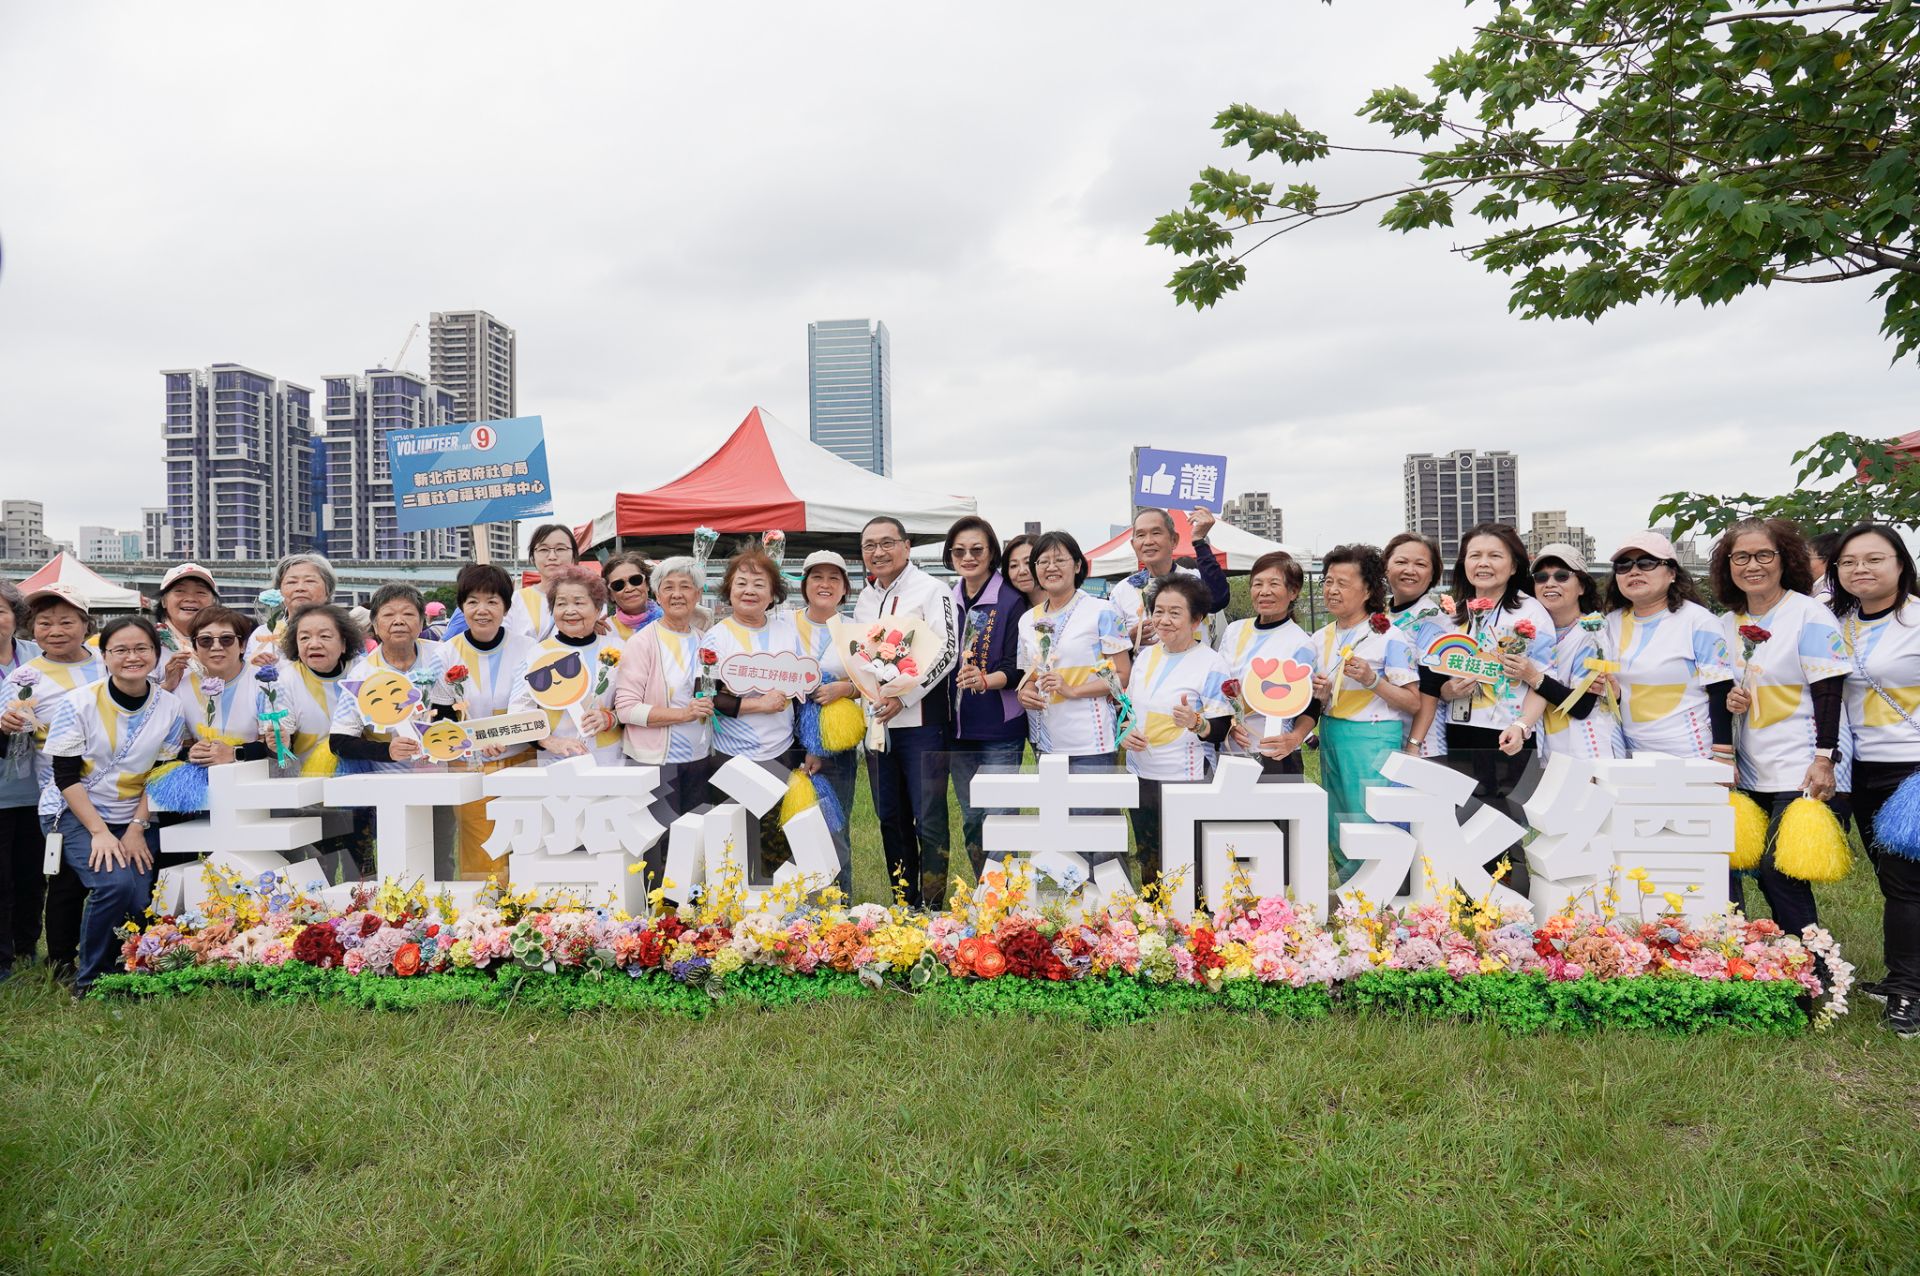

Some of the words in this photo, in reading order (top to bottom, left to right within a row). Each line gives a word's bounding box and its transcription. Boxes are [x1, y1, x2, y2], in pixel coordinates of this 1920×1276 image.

[397, 435, 460, 456] VOLUNTEER
[477, 428, 490, 449] 9
[414, 461, 528, 487] 新北市政府社會局
[1179, 463, 1219, 502] 讚
[402, 479, 545, 508] 三重社會福利服務中心
[726, 663, 803, 684] 三重志工好棒棒!
[475, 719, 546, 740] 最優秀志工隊
[969, 750, 1735, 926] 志向永續
